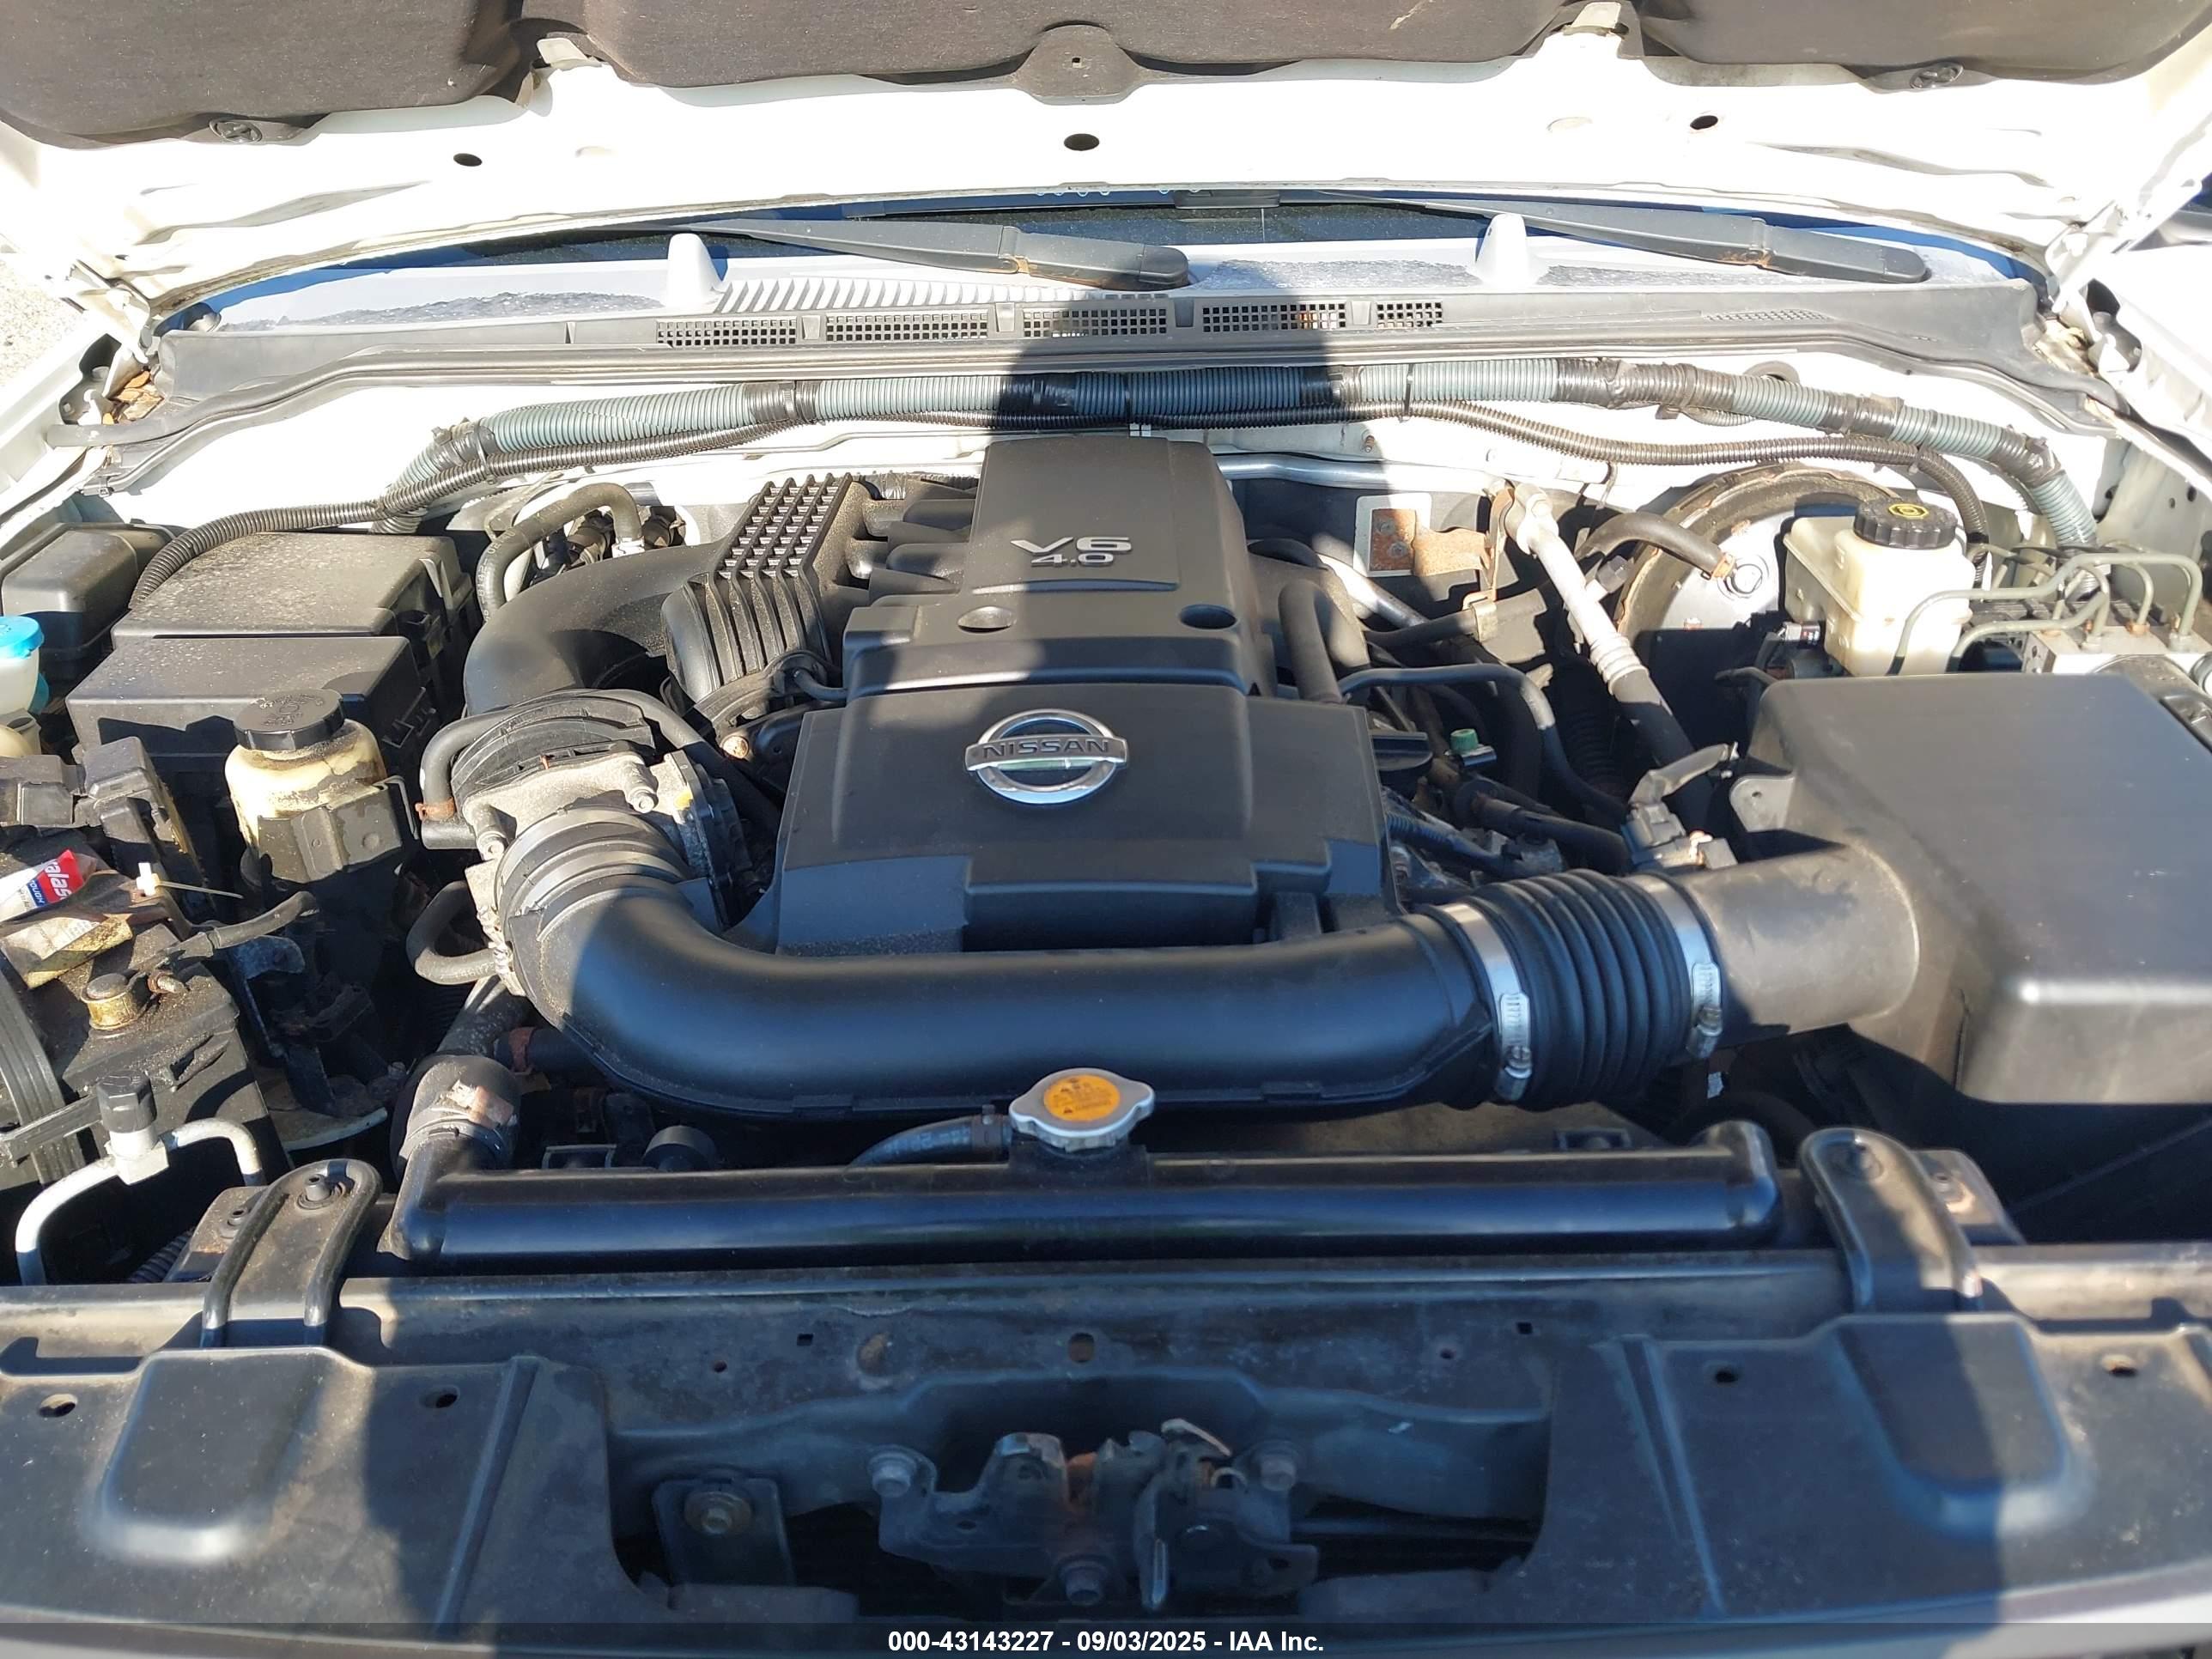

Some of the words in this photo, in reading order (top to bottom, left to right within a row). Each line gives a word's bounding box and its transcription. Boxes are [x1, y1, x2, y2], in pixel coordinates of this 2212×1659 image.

[1011, 537, 1133, 553] V6
[1031, 553, 1114, 567] 4.0
[982, 738, 1109, 758] NISSAN
